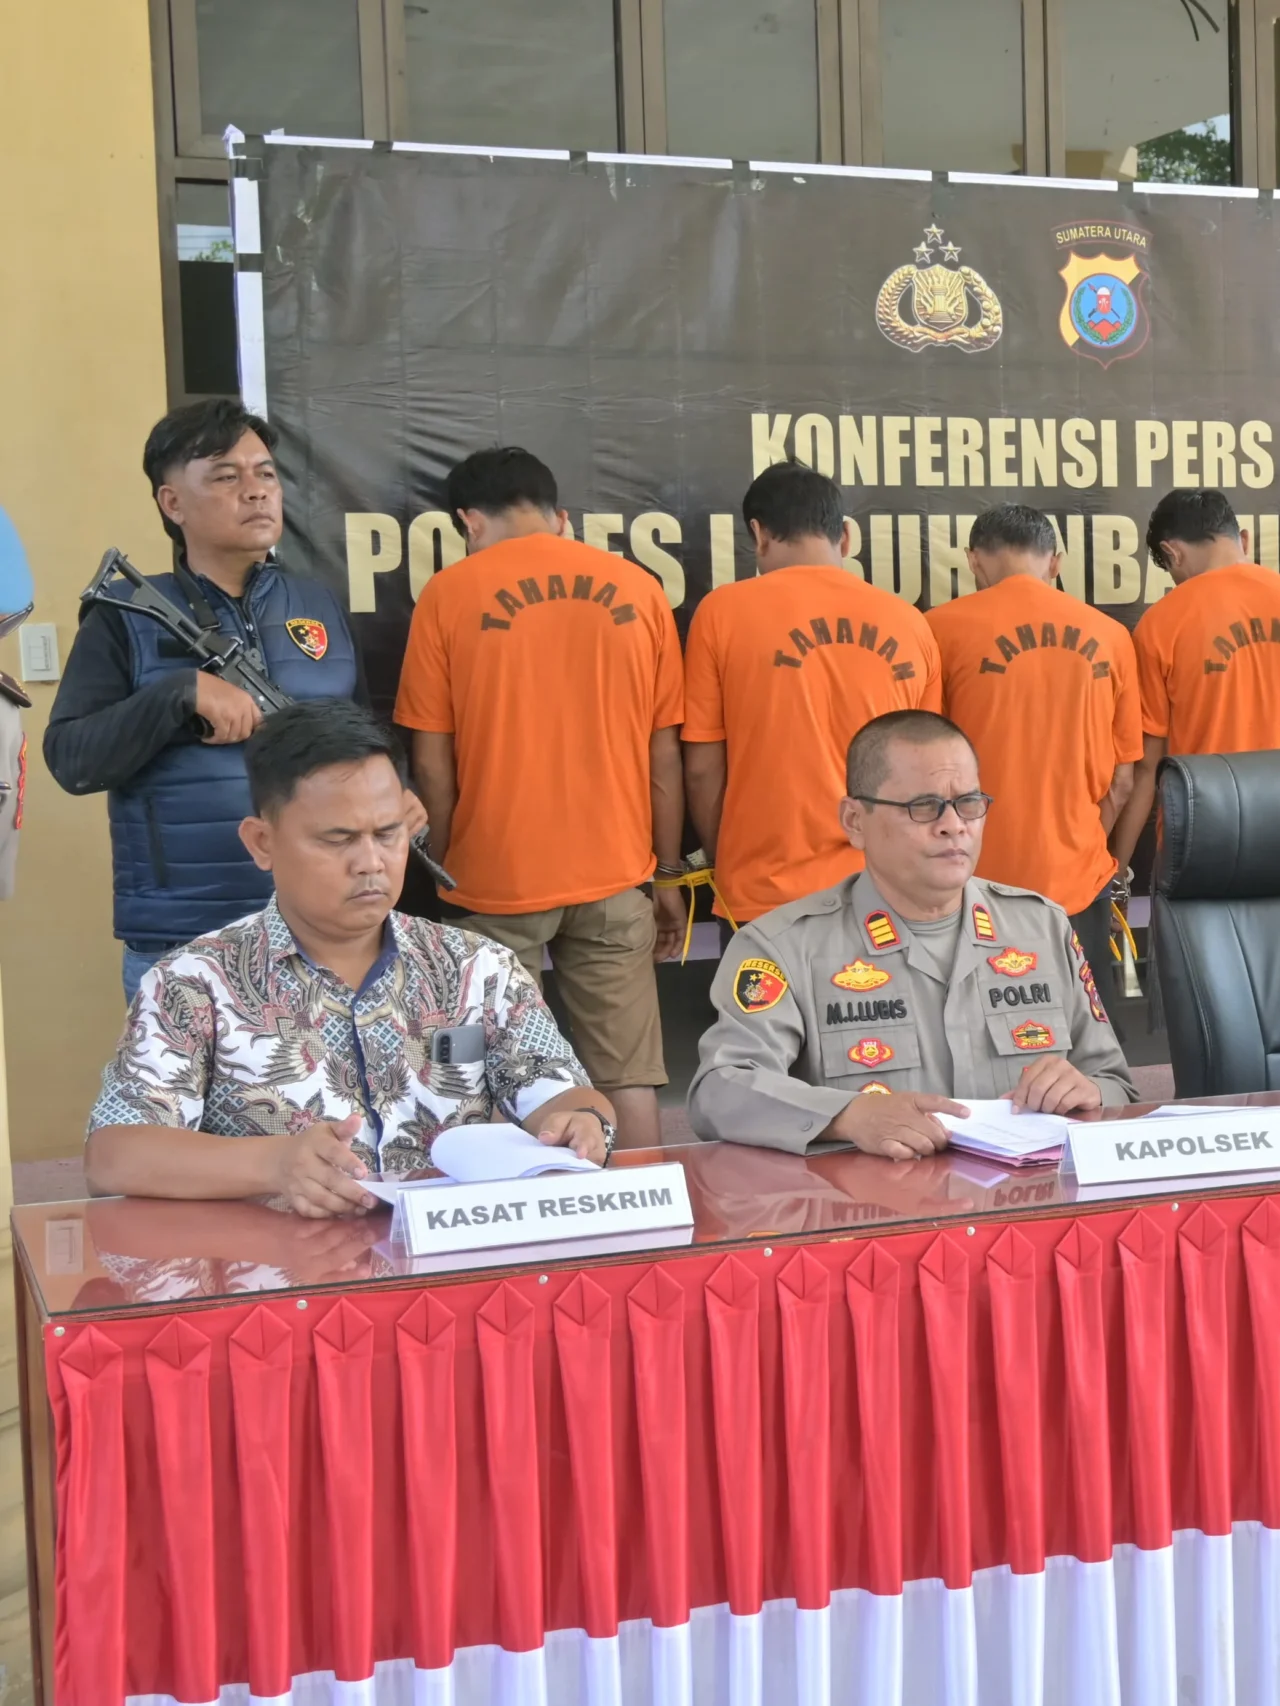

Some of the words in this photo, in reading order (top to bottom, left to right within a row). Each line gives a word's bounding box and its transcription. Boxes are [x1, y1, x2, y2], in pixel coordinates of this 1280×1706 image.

[1056, 226, 1112, 244] SUMATERA
[1114, 228, 1147, 248] UTARA
[751, 413, 1118, 489] KONFERENSI
[1135, 420, 1275, 489] PERS
[345, 511, 686, 613] POS
[481, 574, 638, 631] TAHANAN
[773, 617, 916, 681] TAHANAN
[979, 622, 1110, 680] TAHANAN
[826, 999, 908, 1025] M.I.LUBIS
[988, 983, 1052, 1008] POLRI
[1115, 1131, 1273, 1161] KAPOLSEK
[426, 1201, 528, 1230] KASAT
[538, 1188, 673, 1218] RESKRIM
